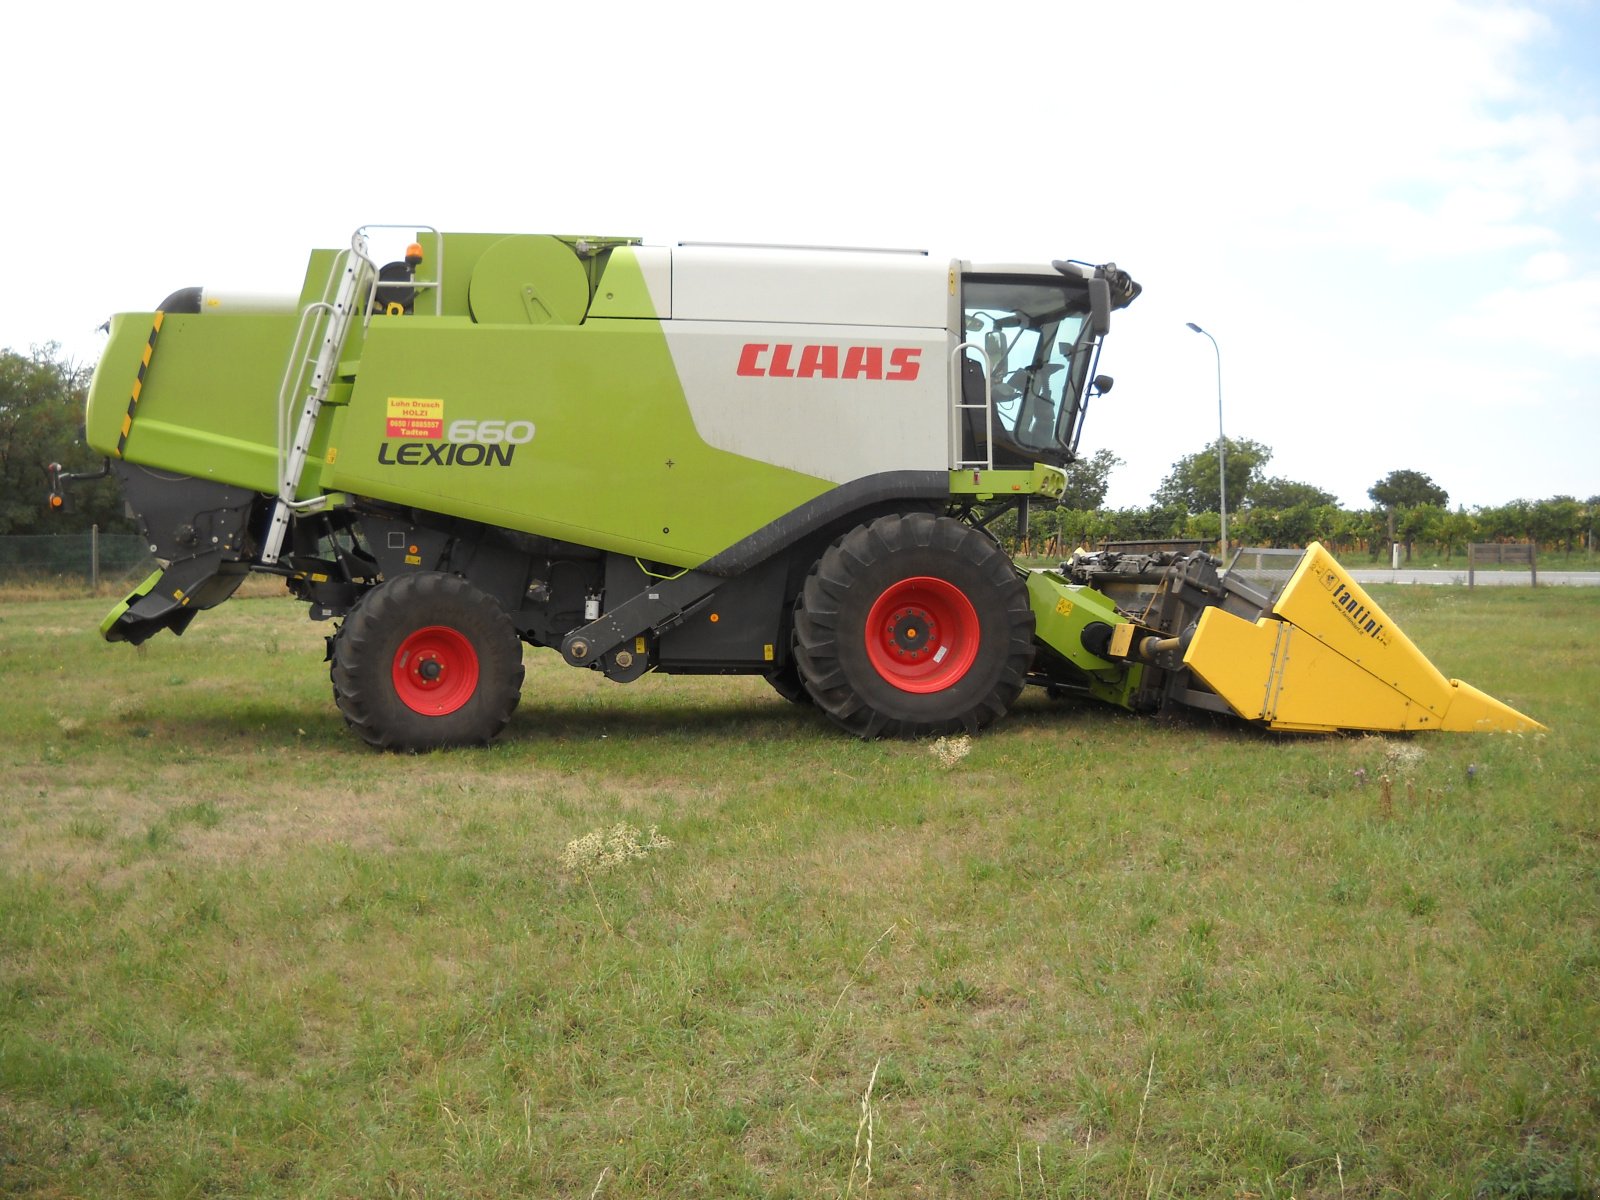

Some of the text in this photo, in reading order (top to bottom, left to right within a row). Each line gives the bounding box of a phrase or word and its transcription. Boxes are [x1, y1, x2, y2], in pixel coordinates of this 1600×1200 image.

[737, 343, 922, 381] CLAAS
[400, 428, 428, 436] Tadten
[448, 420, 536, 444] 660
[378, 442, 515, 467] LEXION
[1333, 584, 1383, 638] fantini
